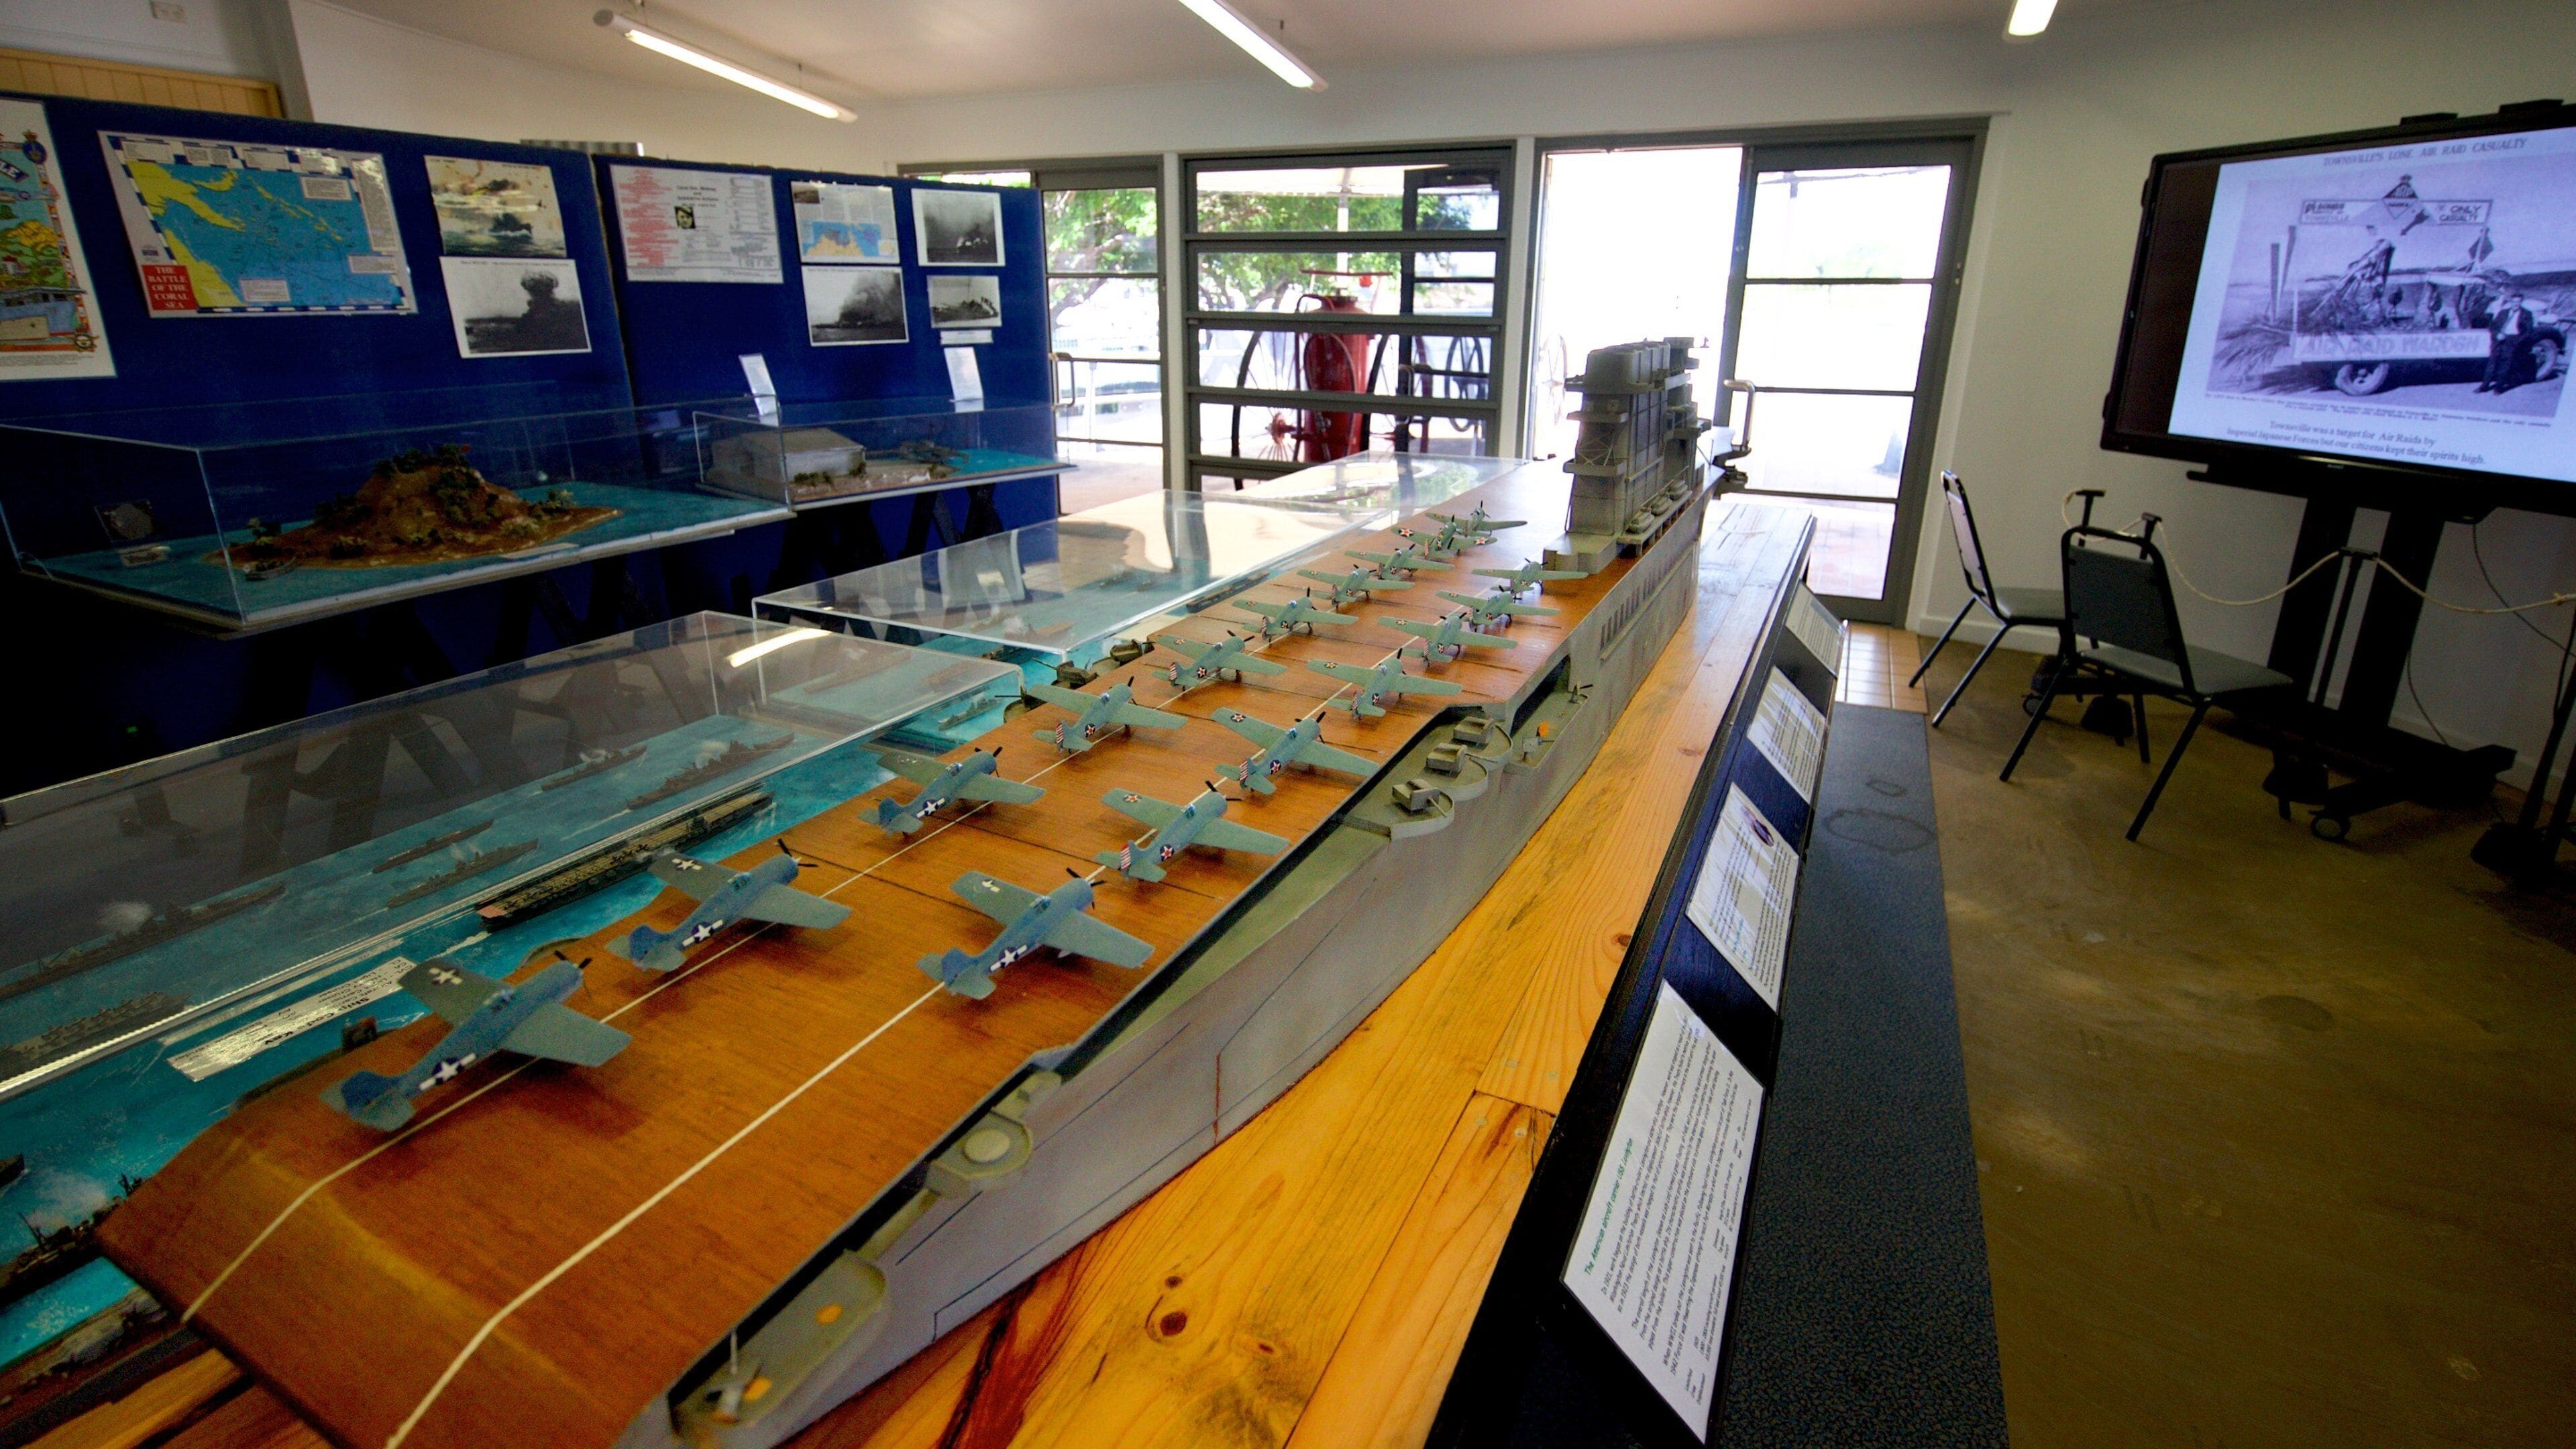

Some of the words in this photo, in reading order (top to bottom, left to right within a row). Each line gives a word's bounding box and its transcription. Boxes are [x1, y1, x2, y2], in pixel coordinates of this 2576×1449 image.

[2419, 147, 2437, 158] AIR
[2442, 144, 2466, 155] RAID
[2473, 138, 2528, 152] CASUALTY
[2439, 214, 2479, 222] CASUALTY
[2270, 420, 2311, 433] Townsville
[2313, 427, 2329, 435] was
[2337, 428, 2361, 439] target
[2363, 429, 2376, 439] for
[2379, 433, 2394, 443] Air
[2396, 434, 2422, 445] Raids
[2423, 436, 2436, 447] by
[2320, 436, 2334, 445] but
[2335, 439, 2350, 448] our
[2351, 440, 2384, 452] citizens
[2385, 444, 2406, 456] kept
[2407, 447, 2428, 458] their
[2430, 450, 2459, 461] spirits
[336, 996, 370, 1012] Ship
[1688, 1096, 1698, 1120] protected
[1676, 1140, 1685, 1162] floating
[1695, 1136, 1703, 1156] provide
[1672, 1158, 1681, 1175] great
[1686, 1165, 1695, 1189] starboard
[1620, 1281, 1629, 1299] 1923
[1627, 1252, 1638, 1276] design
[1638, 1216, 1647, 1238] vessels
[1645, 1188, 1656, 1212] changed
[1656, 1148, 1665, 1169] aircraft
[1666, 1120, 1674, 1136] They
[1674, 1091, 1683, 1108] largest
[1668, 1173, 1676, 1193] formed
[1584, 1258, 1594, 1278] The
[1590, 1225, 1605, 1261] American
[1600, 1199, 1613, 1230] aircraft
[1609, 1177, 1620, 1203] carrier
[1615, 1163, 1625, 1181] USS
[1620, 1135, 1635, 1167] Lexington
[1607, 1255, 1617, 1273] work
[1612, 1239, 1623, 1260] began
[1621, 1203, 1633, 1228] building
[1640, 1143, 1651, 1169] Lexington
[1662, 1201, 1670, 1217] Lady
[1678, 1201, 1687, 1221] placed
[1672, 1308, 1680, 1328] broke
[1680, 1263, 1690, 1292] Lexington
[1697, 1188, 1707, 1214] Following
[1708, 1140, 1717, 1166] Lexington
[1713, 1123, 1721, 1146] operated
[1639, 1320, 1648, 1341] from
[1646, 1289, 1657, 1316] original
[1652, 1271, 1661, 1294] design
[1658, 1244, 1666, 1264] battle
[1667, 1191, 1679, 1227] characteristic
[1675, 1177, 1684, 1197] profile
[1649, 1236, 1661, 1265] Lexington
[1640, 1277, 1651, 1301] length
[1670, 1356, 1678, 1377] 1942
[1674, 1338, 1682, 1360] Force
[1682, 1293, 1693, 1325] thwarting
[1690, 1260, 1700, 1288] Japanese
[1695, 1240, 1704, 1265] attempt
[1705, 1190, 1715, 1214] Moresby
[1634, 1295, 1645, 1319] overall
[1652, 1314, 1660, 1333] from
[1648, 1330, 1657, 1352] pipes
